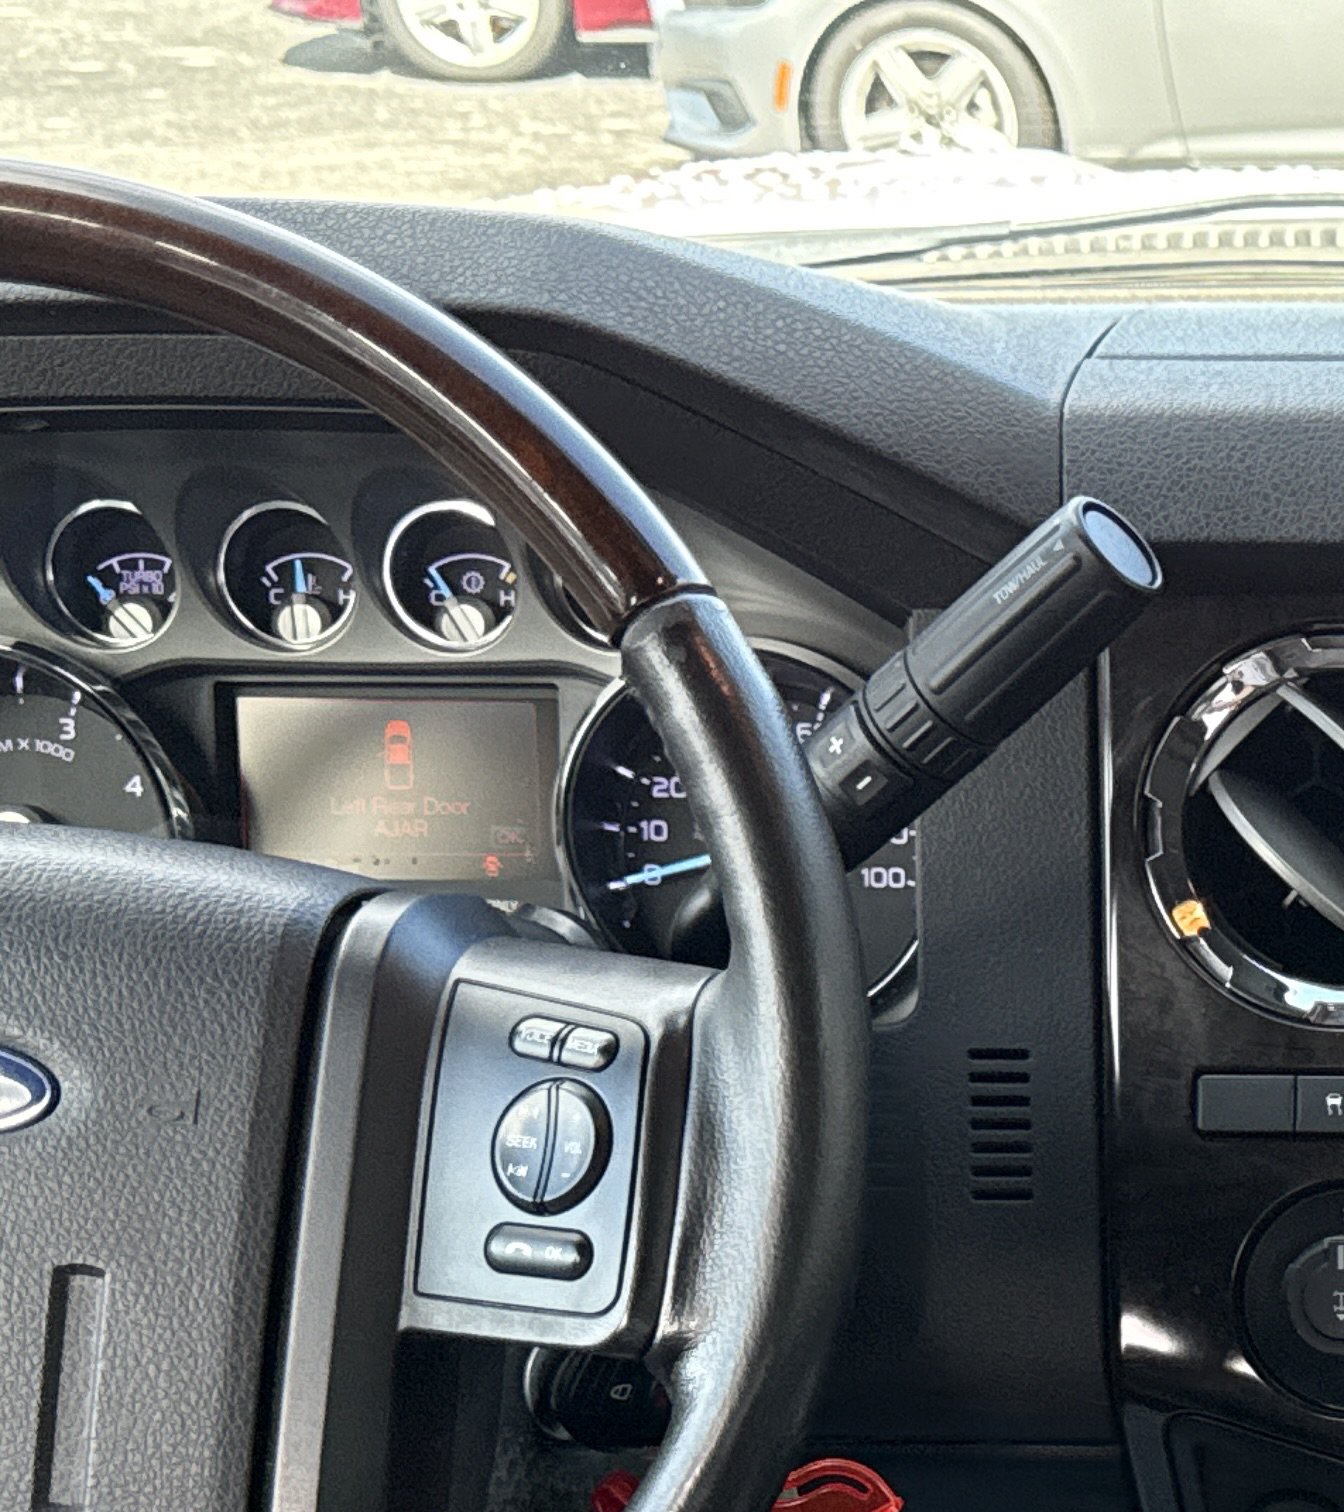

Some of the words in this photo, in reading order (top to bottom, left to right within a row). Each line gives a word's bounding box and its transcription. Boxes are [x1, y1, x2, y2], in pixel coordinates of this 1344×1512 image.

[120, 570, 163, 582] TURBO
[120, 582, 140, 594] PSI
[268, 588, 284, 605] C
[338, 588, 355, 605] H
[500, 589, 515, 606] H
[59, 718, 76, 741] 3
[34, 739, 76, 762] 1000
[124, 775, 144, 797] 4
[331, 797, 366, 815] Left
[373, 797, 415, 815] Rear
[423, 797, 471, 815] Door
[376, 819, 428, 837] AJAR
[639, 819, 669, 842] 10
[861, 867, 906, 888] 100
[505, 1135, 538, 1150] SEEK
